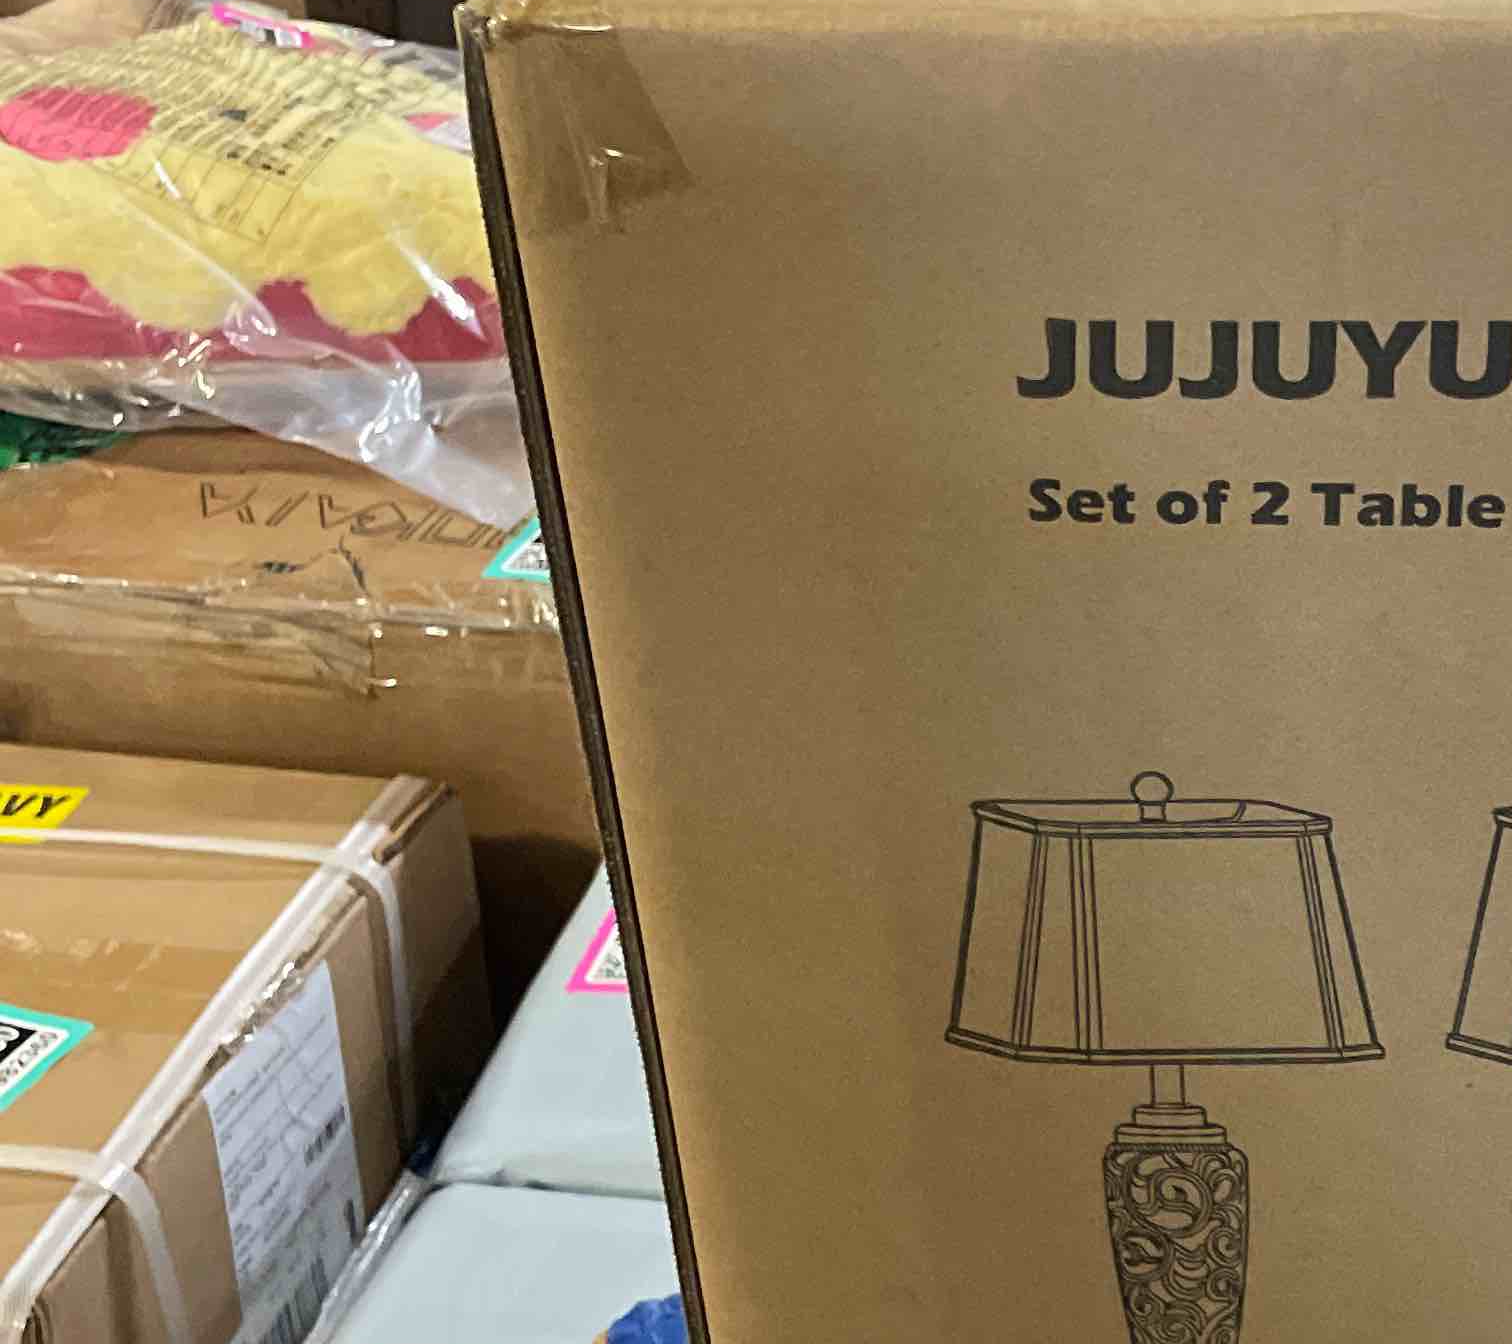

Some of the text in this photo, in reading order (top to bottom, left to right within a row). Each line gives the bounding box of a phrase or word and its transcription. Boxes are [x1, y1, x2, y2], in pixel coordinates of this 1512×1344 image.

[1027, 477, 1136, 524] Set
[1156, 478, 1231, 525] of
[1249, 480, 1291, 525] 2
[1310, 481, 1506, 529] Table
